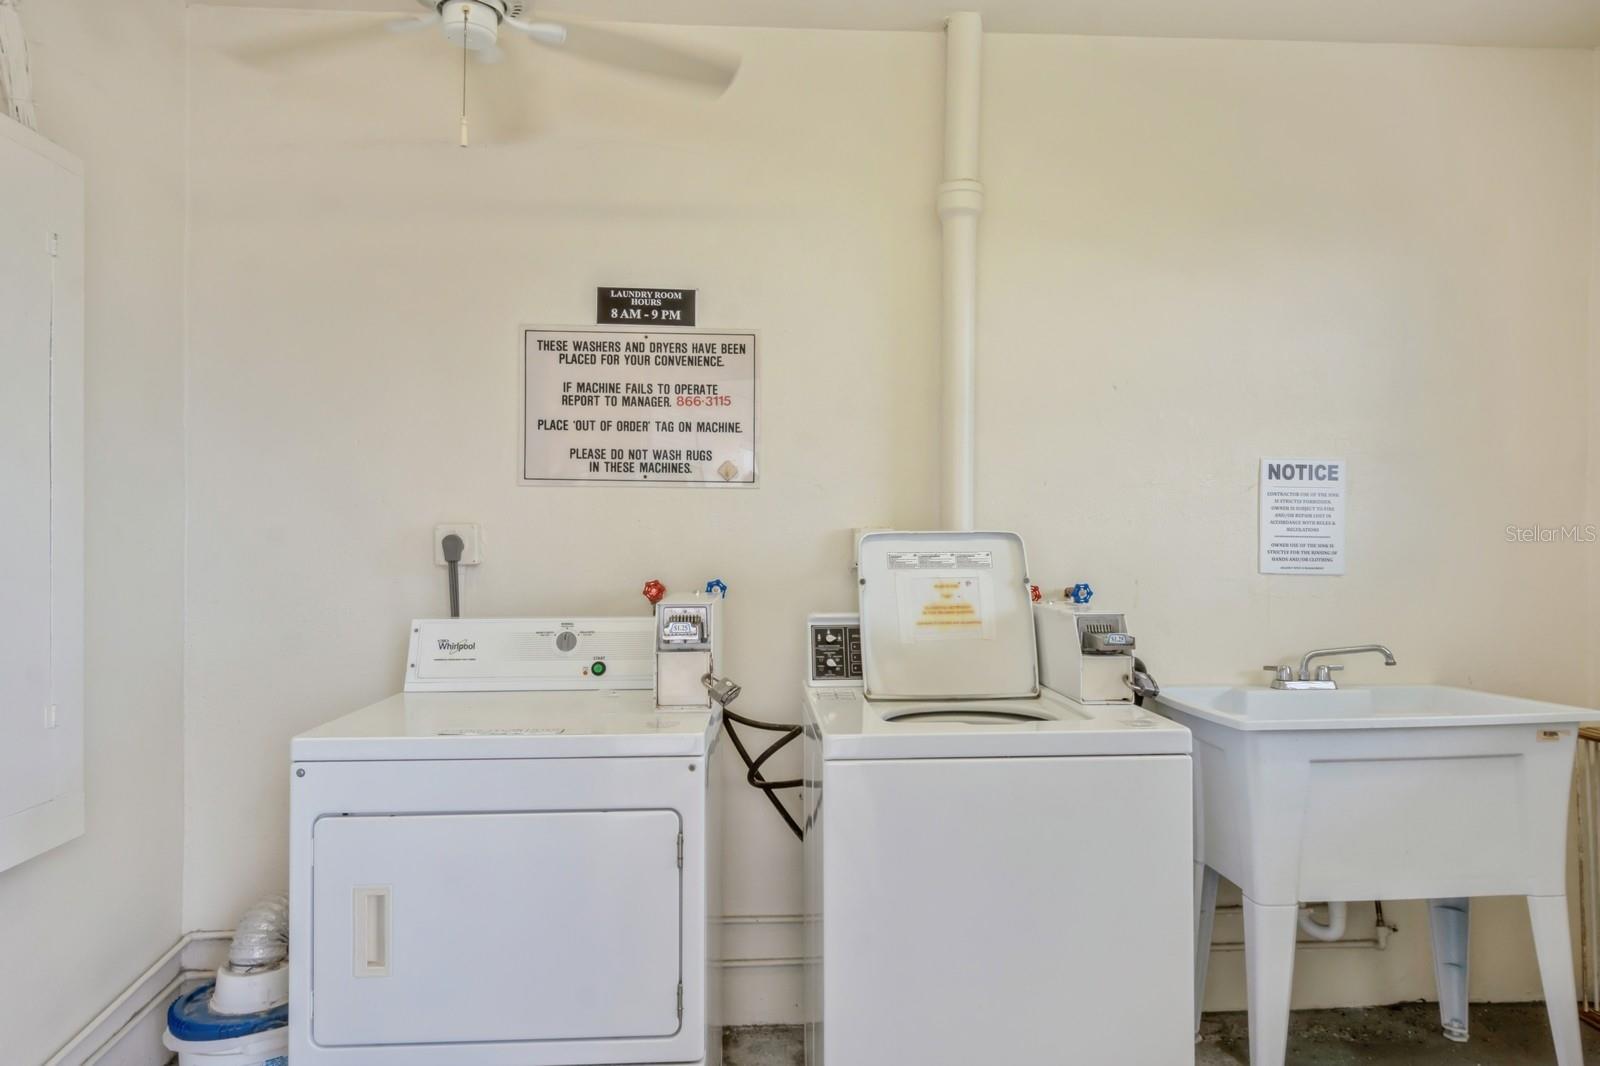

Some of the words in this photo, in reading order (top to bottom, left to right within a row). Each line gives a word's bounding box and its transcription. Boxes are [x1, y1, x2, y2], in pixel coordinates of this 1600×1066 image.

[610, 290, 653, 298] LAUNDRY
[611, 308, 618, 318] 8
[620, 309, 641, 319] AM
[651, 309, 659, 320] 9
[661, 310, 681, 320] PM
[537, 340, 567, 351] THESE
[573, 341, 621, 352] WASHERS
[625, 342, 645, 353] AND
[650, 342, 688, 353] DRYERS
[692, 343, 717, 354] HAVE
[722, 344, 746, 354] BEEN
[559, 353, 596, 365] PLACED
[601, 354, 620, 365] FOR
[624, 355, 650, 366] YOUR
[655, 355, 724, 367] CONVENIENCE.
[563, 382, 572, 393] IF
[577, 382, 621, 394] MACHINE
[626, 383, 653, 395] FAILS
[658, 384, 671, 394] TO
[675, 384, 718, 395] OPERATE
[562, 395, 600, 406] REPORT
[605, 396, 617, 407] TO
[622, 396, 672, 407] MANAGER.
[537, 419, 569, 431] PLACE
[600, 420, 612, 432] OF
[656, 421, 674, 432] TAG
[679, 422, 692, 432] ON
[697, 422, 743, 433] MACHINE.
[569, 448, 606, 460] PLEASE
[611, 449, 624, 460] DO
[629, 449, 648, 460] NOT
[653, 449, 682, 461] WASH
[686, 450, 712, 461] RUGS
[589, 461, 600, 473] IN
[604, 461, 635, 473] THESE
[639, 462, 692, 474] MACHINES.
[1268, 463, 1339, 481] NOTICE
[438, 642, 476, 652] Whirlpool
